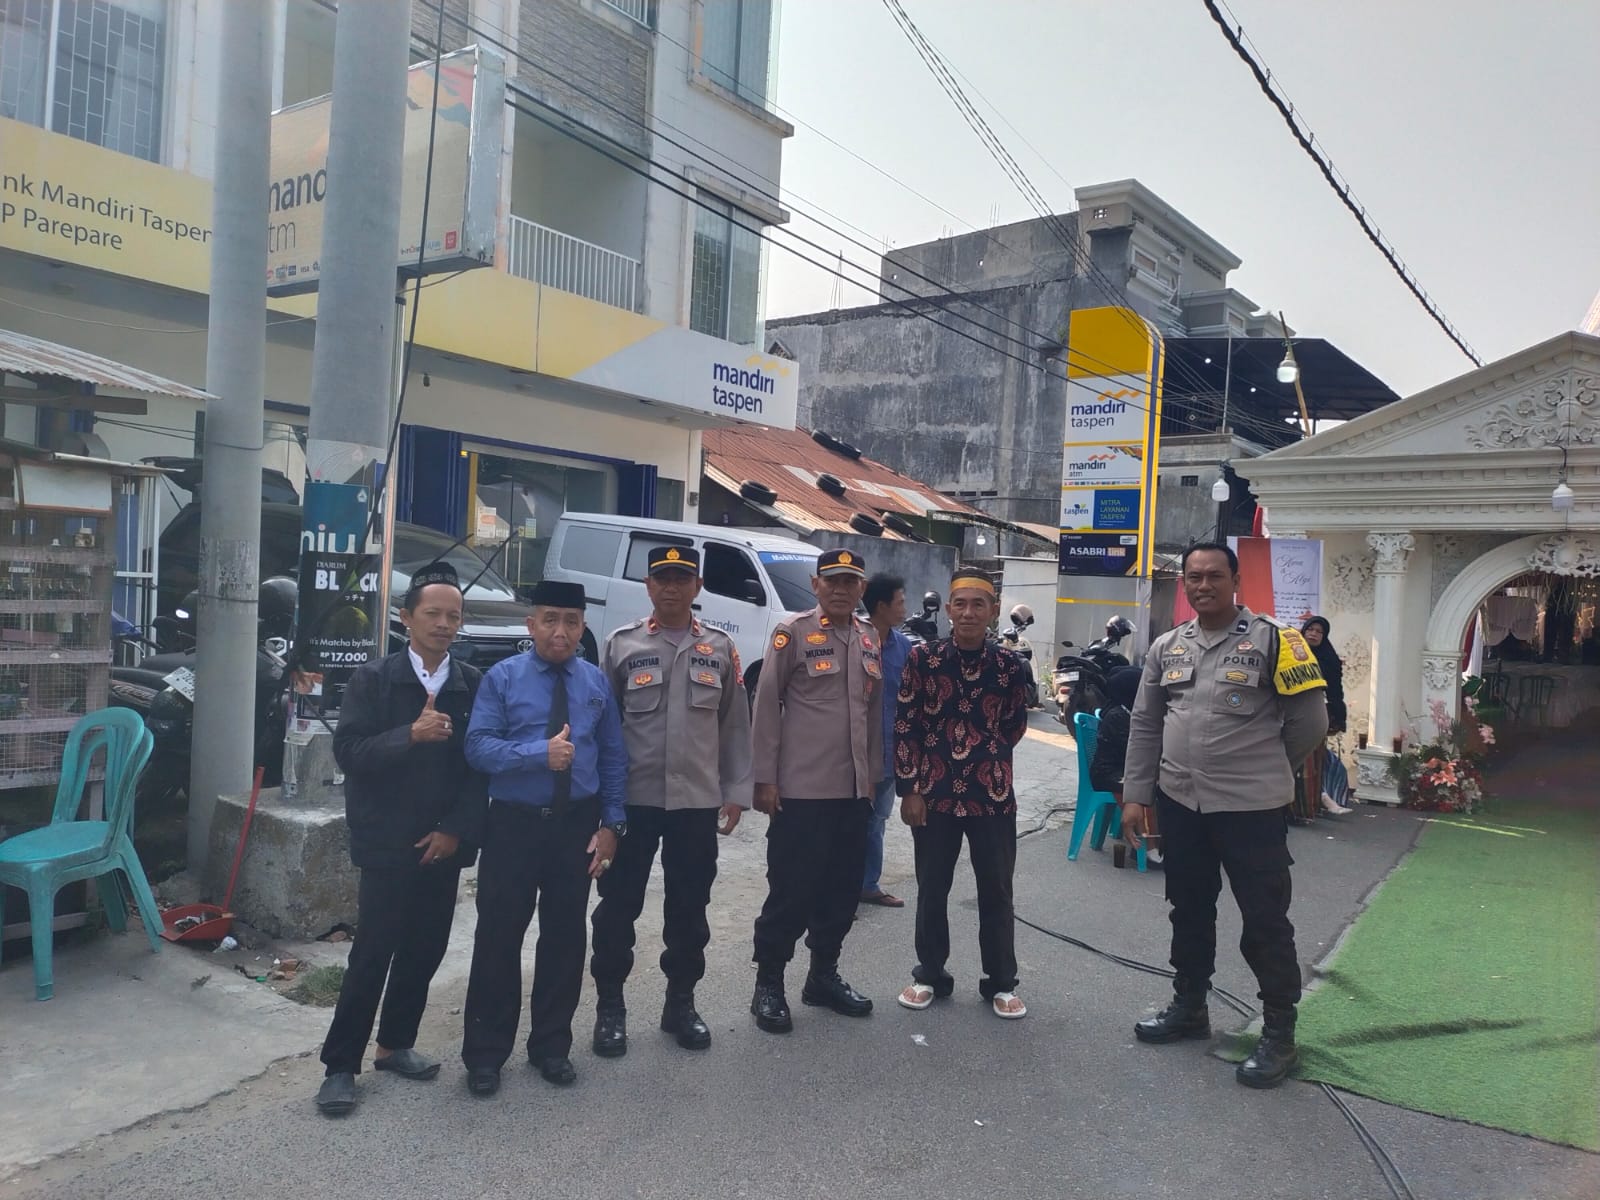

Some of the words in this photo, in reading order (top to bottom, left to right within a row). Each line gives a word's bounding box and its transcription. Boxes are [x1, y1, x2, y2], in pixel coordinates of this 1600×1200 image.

[41, 180, 134, 223] Mandiri
[24, 208, 123, 250] Parepare
[713, 362, 774, 395] mandiri
[712, 385, 763, 414] taspen
[1071, 400, 1126, 415] mandiri
[1071, 416, 1114, 430] taspen
[1069, 460, 1106, 470] mandiri
[1064, 508, 1089, 516] taspen
[1069, 547, 1106, 556] ASABRI
[319, 638, 350, 647] Matcha
[352, 638, 361, 649] by
[331, 652, 368, 662] 17.000
[691, 657, 720, 669] POLRI
[1223, 656, 1260, 667] POLRI
